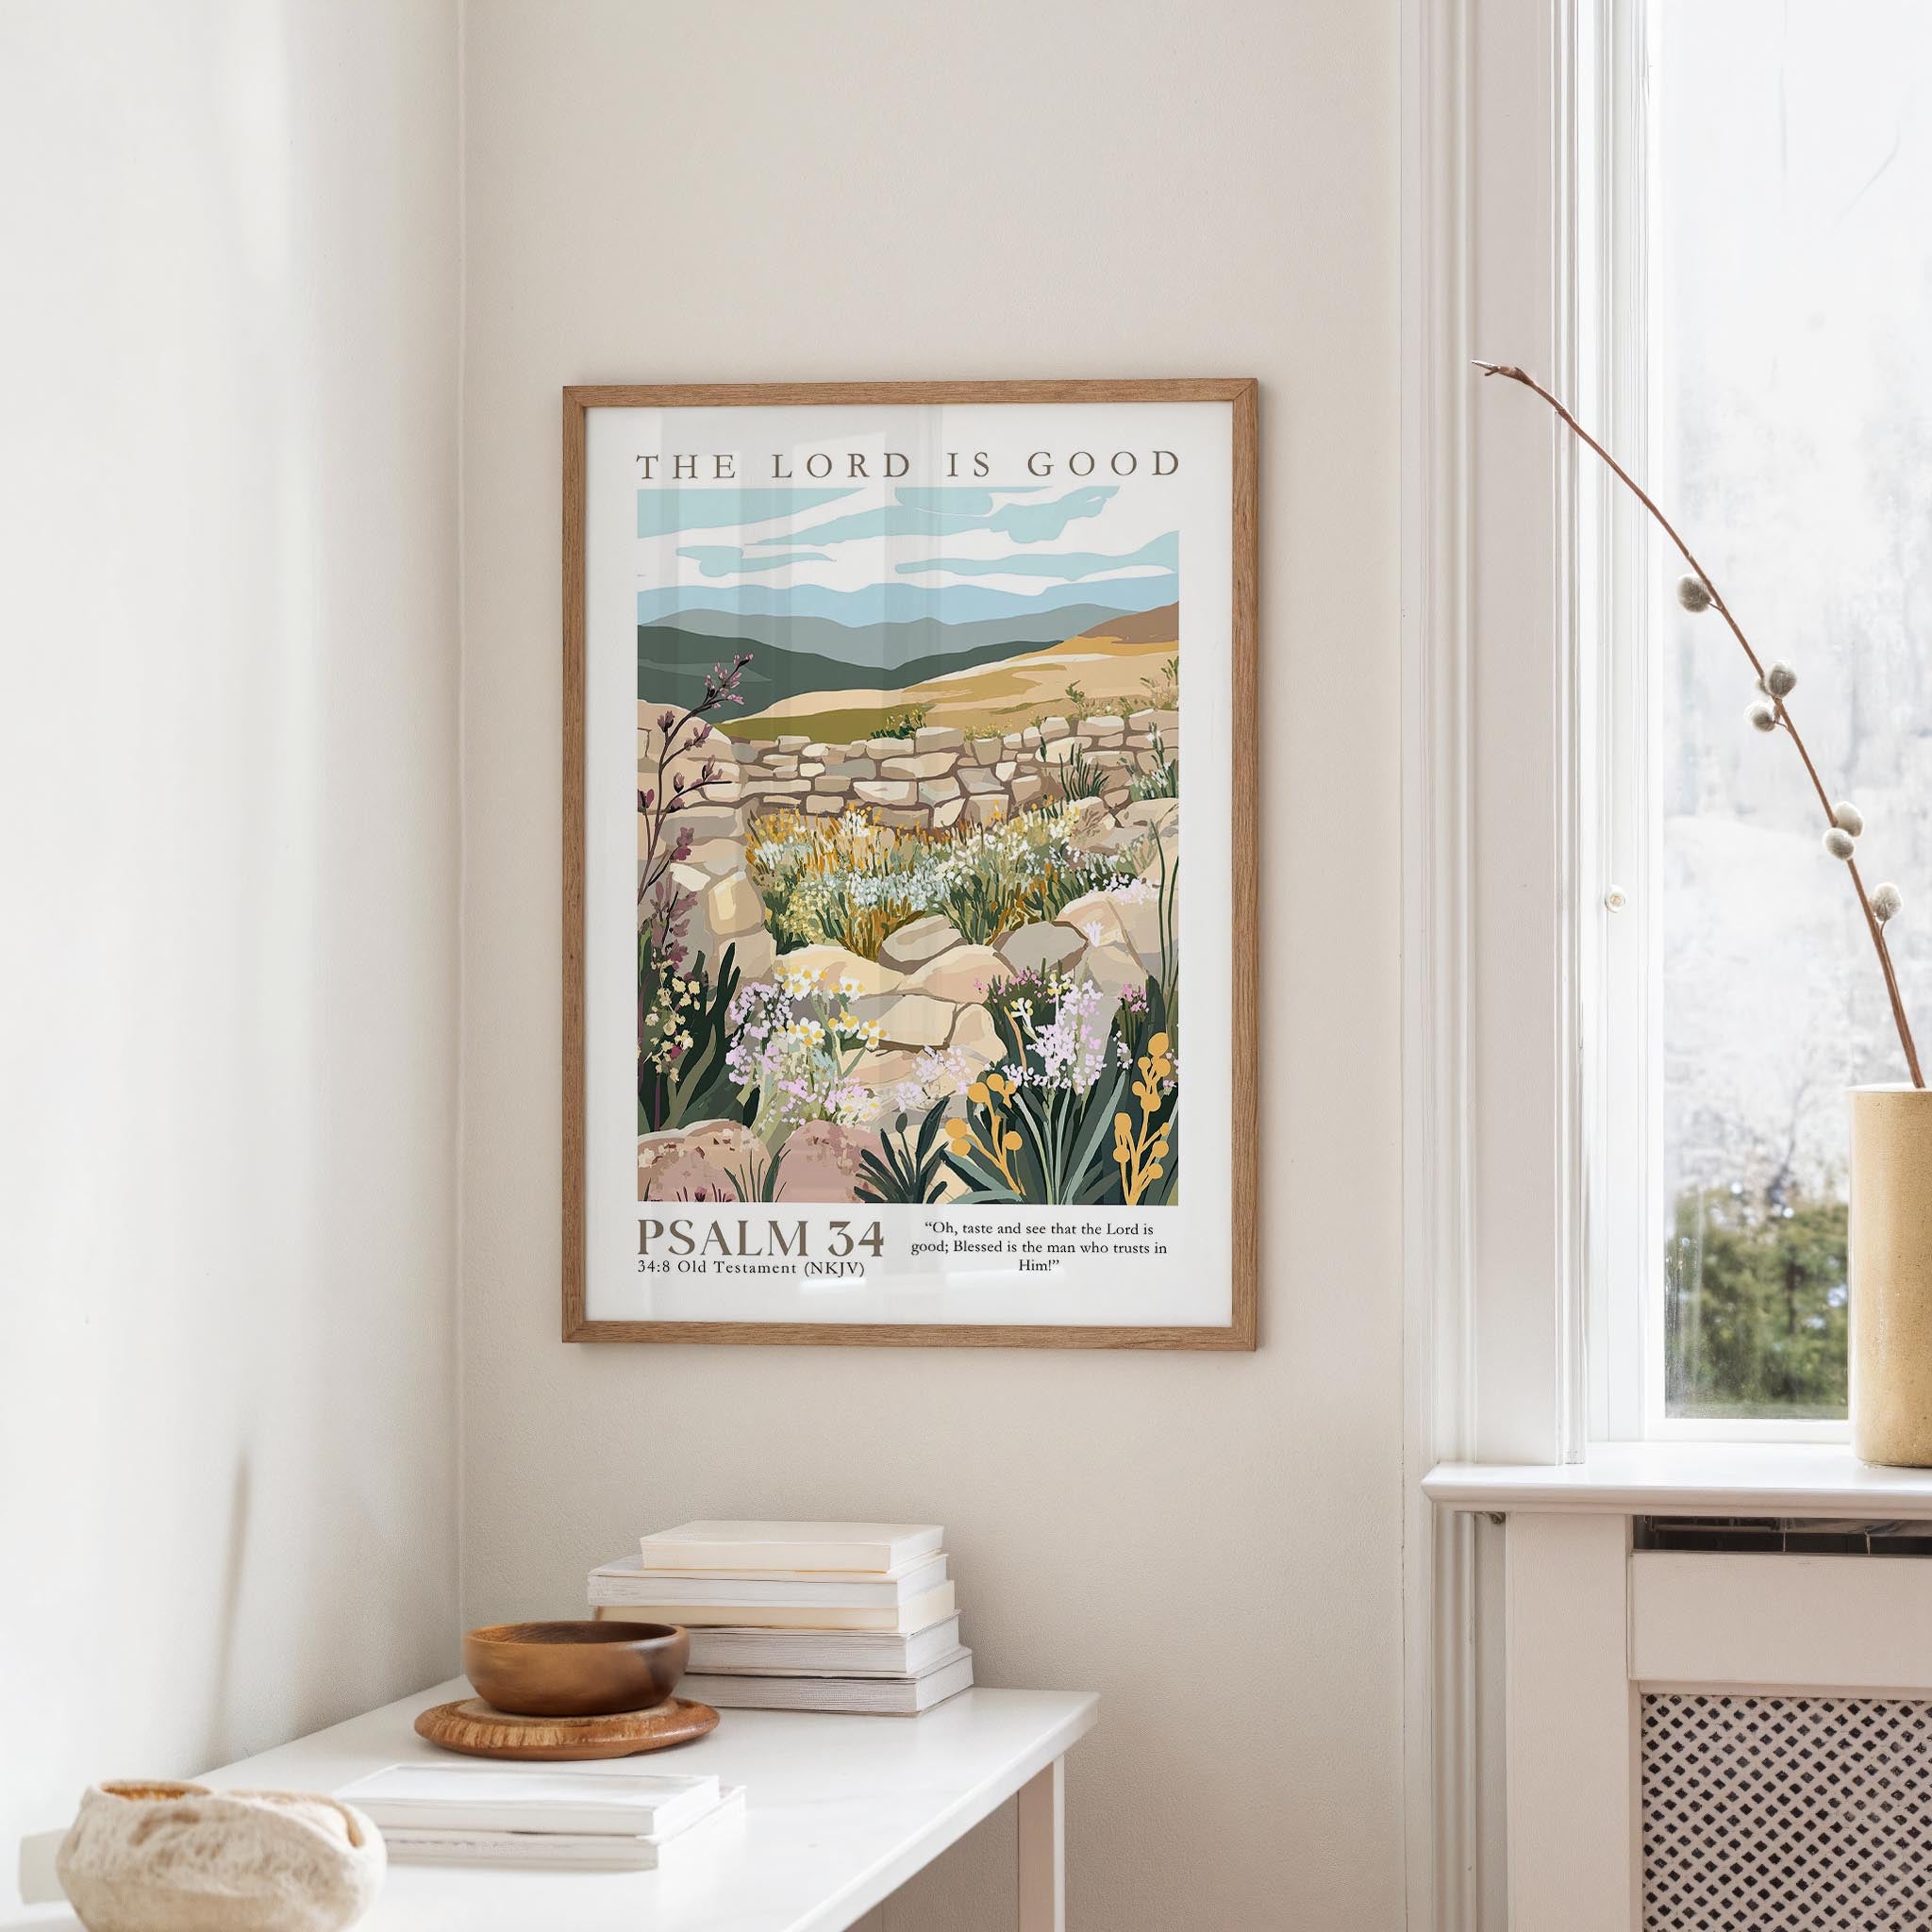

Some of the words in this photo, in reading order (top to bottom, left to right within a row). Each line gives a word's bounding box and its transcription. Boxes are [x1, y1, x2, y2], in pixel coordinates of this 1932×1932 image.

[637, 455, 735, 479] THE
[772, 453, 909, 477] LORD
[947, 452, 989, 476] IS
[1028, 451, 1178, 476] GOOD
[637, 1219, 808, 1256] PSALM
[827, 1221, 885, 1257] 34
[962, 1224, 993, 1235] taste
[997, 1223, 1022, 1235] and
[1025, 1224, 1046, 1235] see
[1051, 1222, 1077, 1235] that
[1081, 1223, 1102, 1235] the
[1106, 1223, 1140, 1236] Lord
[1143, 1223, 1154, 1236] is
[910, 1240, 949, 1256] good;
[953, 1240, 1003, 1253] Blessed
[1007, 1241, 1018, 1253] is
[1022, 1241, 1042, 1253] the
[1046, 1243, 1076, 1254] man
[1080, 1241, 1109, 1254] who
[1113, 1242, 1150, 1255] trusts
[1154, 1241, 1168, 1255] in
[637, 1259, 671, 1274] 34:8
[677, 1259, 707, 1274] Old
[713, 1260, 797, 1274] Testament
[804, 1261, 865, 1278] (NKJV)
